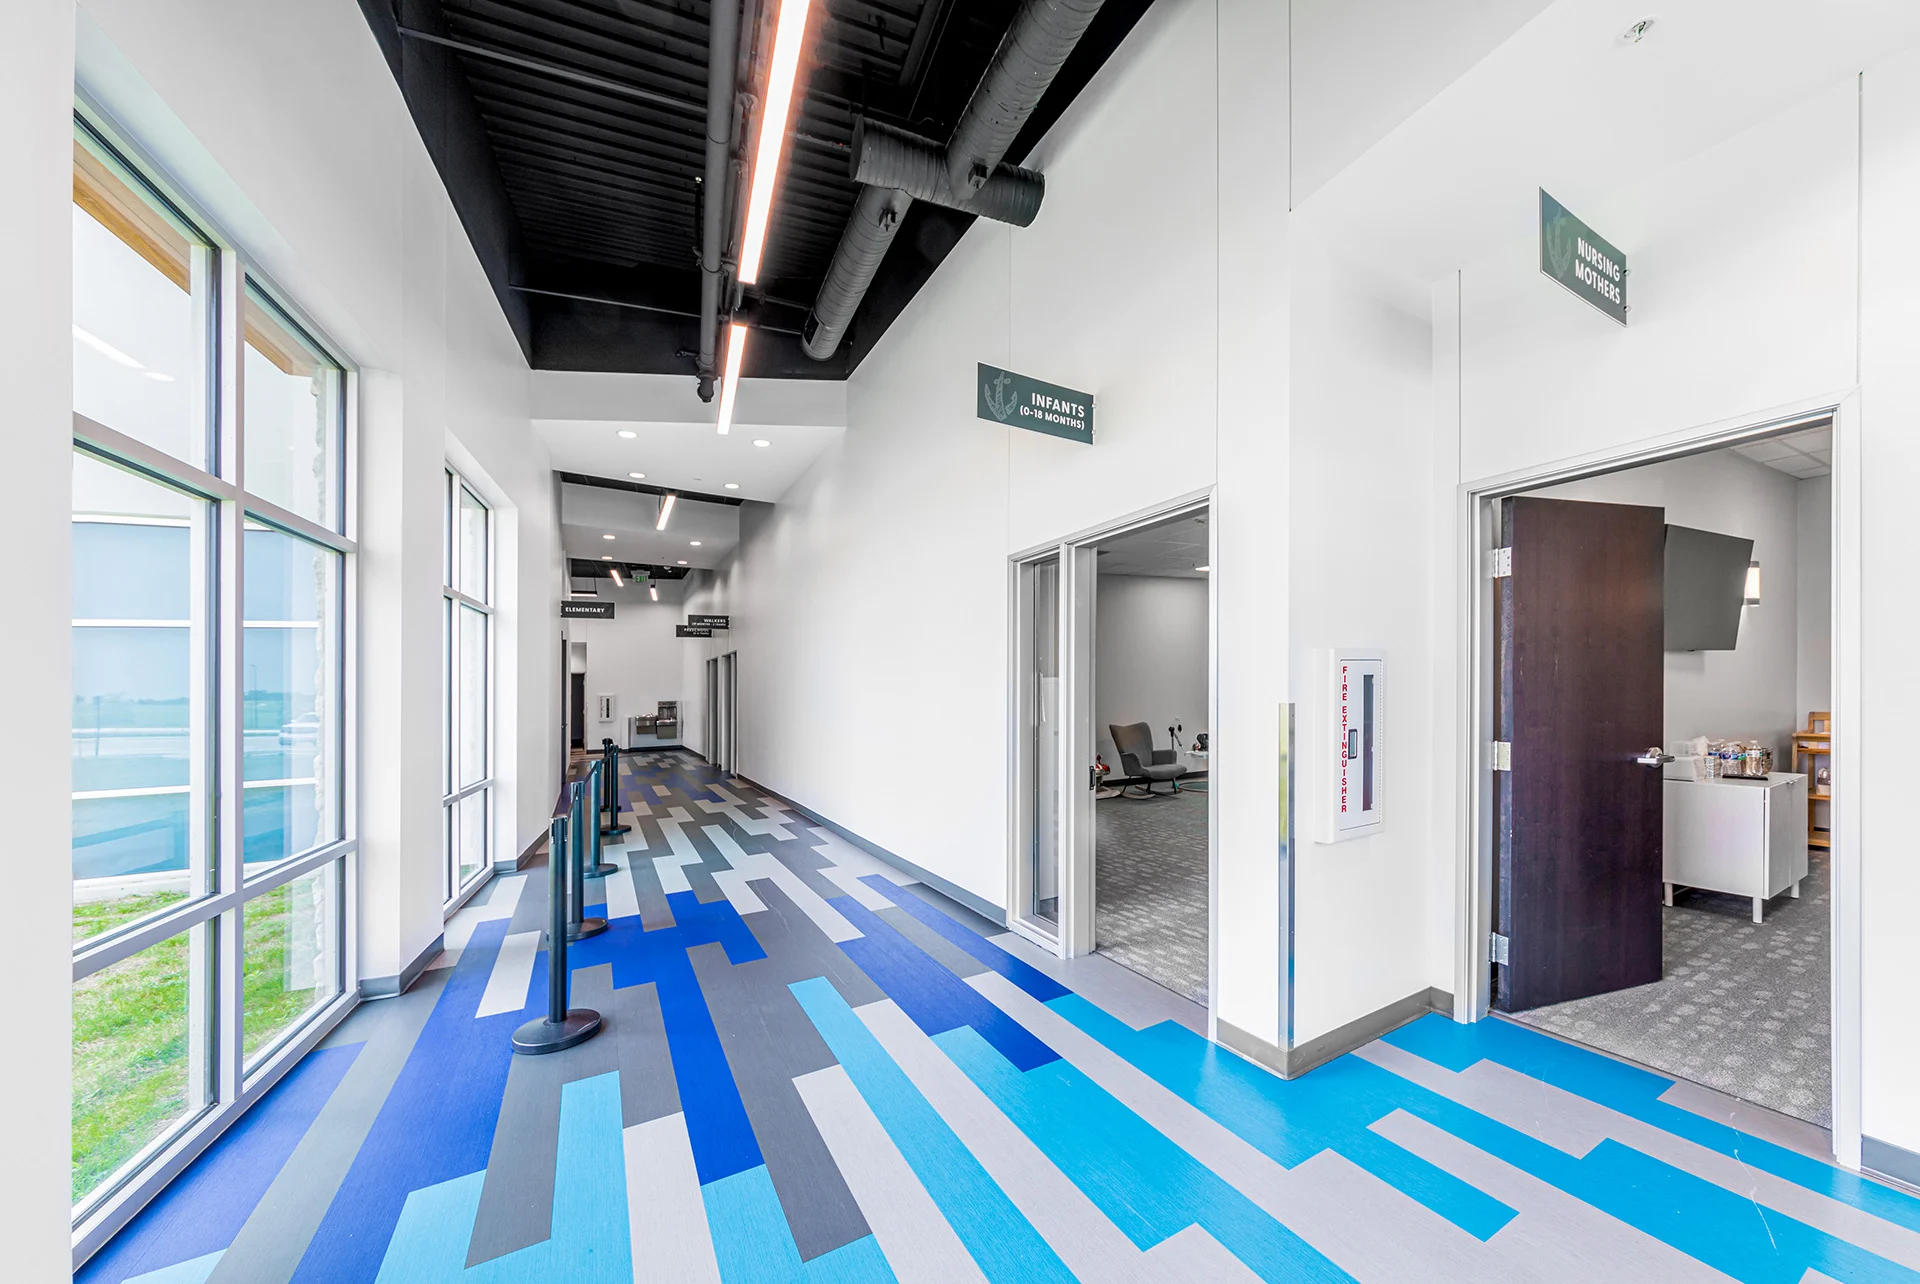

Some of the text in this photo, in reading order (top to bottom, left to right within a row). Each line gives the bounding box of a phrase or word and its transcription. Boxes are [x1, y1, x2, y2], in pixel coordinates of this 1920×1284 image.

[1577, 237, 1620, 282] NURSING
[1575, 258, 1620, 304] MOTHERS
[1020, 405, 1085, 431] (0-18 MONTHS)
[1031, 392, 1085, 418] INFANTS
